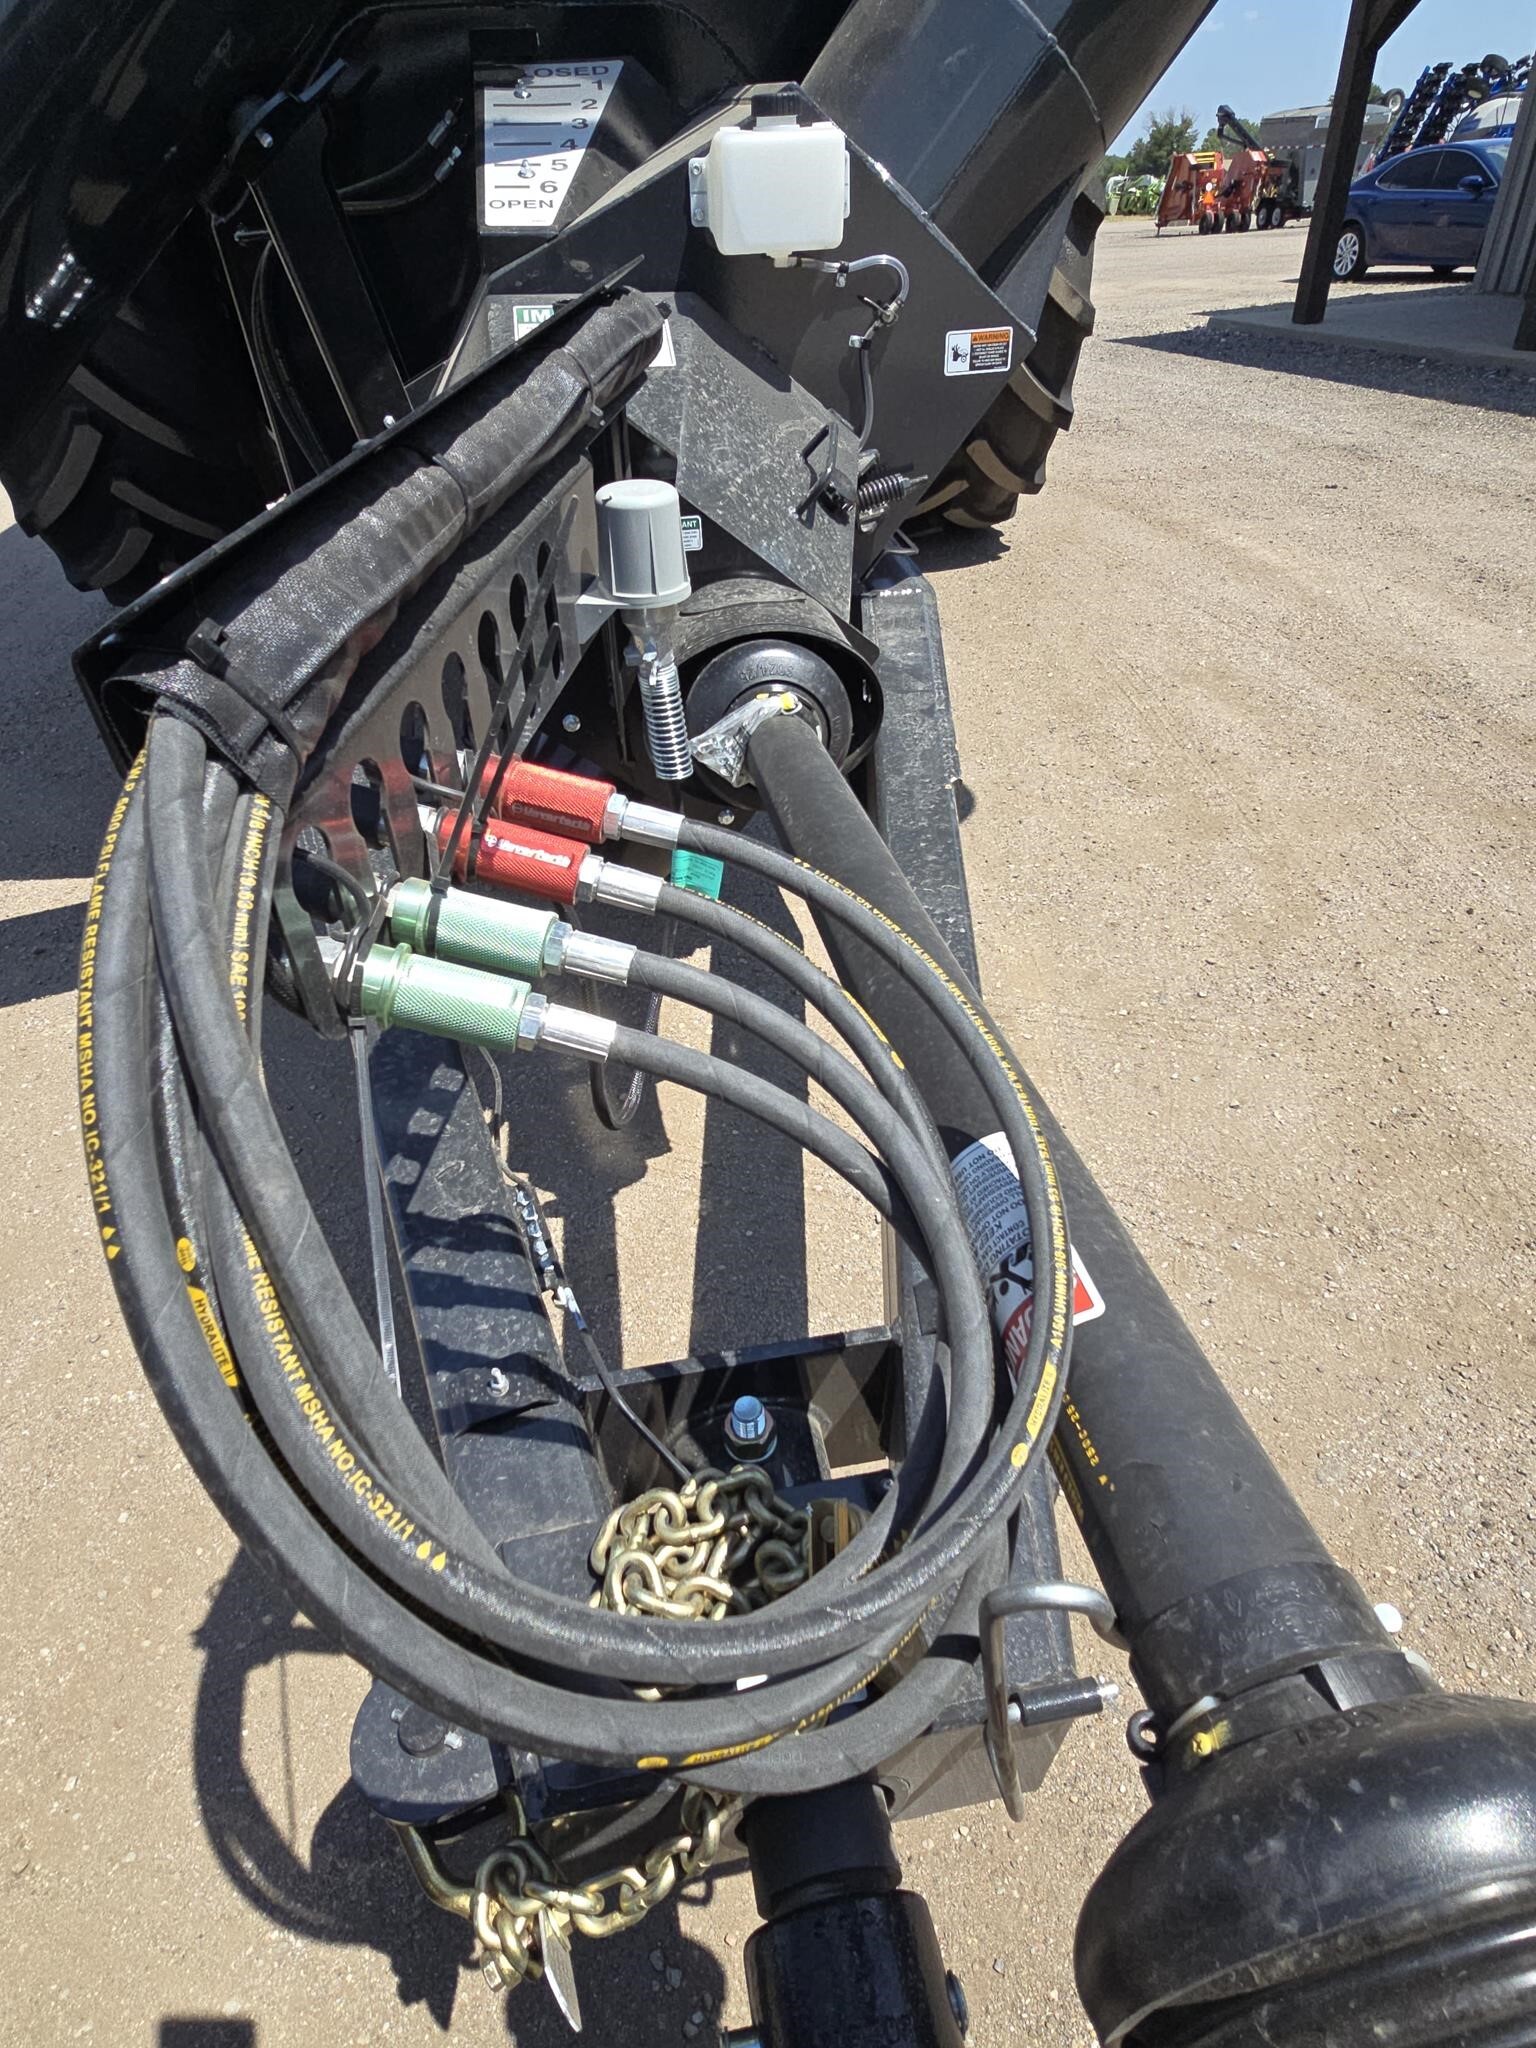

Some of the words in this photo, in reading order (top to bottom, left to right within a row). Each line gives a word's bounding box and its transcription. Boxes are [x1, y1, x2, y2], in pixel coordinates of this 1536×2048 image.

[592, 80, 603, 91] 1
[581, 99, 599, 110] 2
[571, 118, 589, 130] 3
[559, 138, 578, 150] 4
[551, 159, 569, 171] 5
[540, 181, 558, 194] 6
[489, 200, 553, 209] OPEN
[978, 332, 1009, 341] WARNING
[682, 520, 697, 528] ANT
[108, 797, 129, 832] 5000
[99, 833, 117, 861] PSI
[242, 830, 264, 870] INCH
[88, 862, 110, 921] FLAME
[229, 951, 250, 987] SAE
[898, 930, 950, 984] RESISTANT
[79, 924, 98, 1028] RESISTANT
[945, 980, 976, 1017] FLAME
[79, 1031, 94, 1092] MSHA
[968, 1153, 986, 1168] NOT
[1035, 1136, 1049, 1161] SAE
[991, 1206, 1010, 1222] NOT
[978, 1219, 1003, 1250] KEEP
[989, 1227, 1030, 1265] OTATING
[992, 1219, 1026, 1247] CONTACT
[1051, 1218, 1066, 1249] INCH
[194, 1296, 231, 1369] HYDRALITE
[252, 1272, 307, 1383] RESISTANT
[294, 1382, 336, 1444] MSHA
[1028, 1379, 1050, 1427] HYDRALITE
